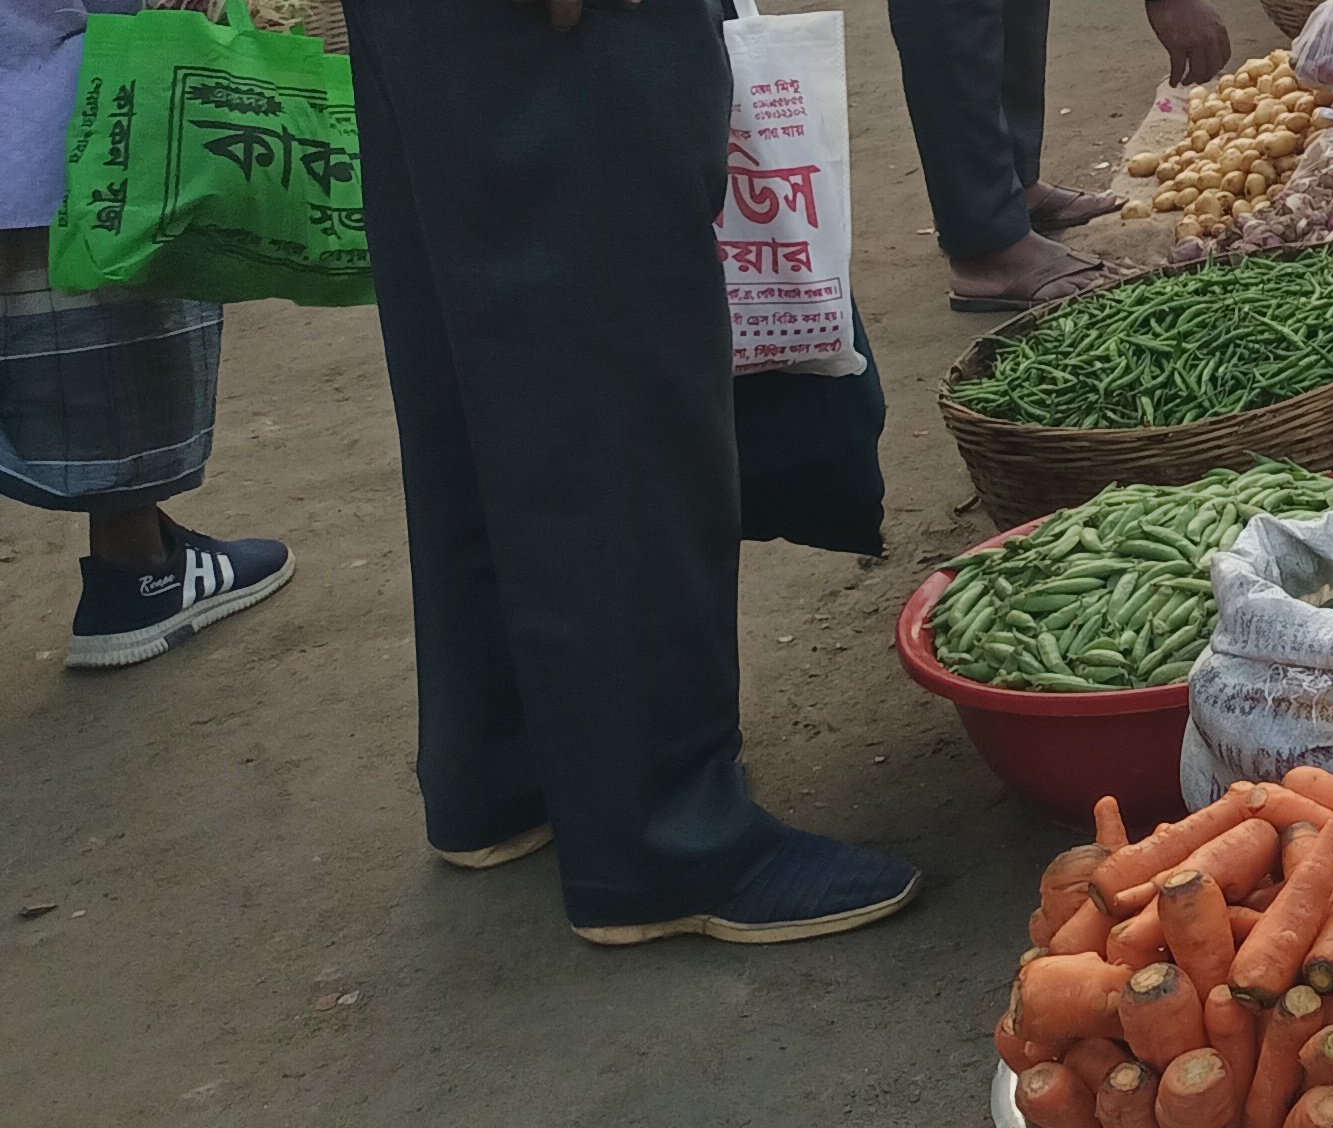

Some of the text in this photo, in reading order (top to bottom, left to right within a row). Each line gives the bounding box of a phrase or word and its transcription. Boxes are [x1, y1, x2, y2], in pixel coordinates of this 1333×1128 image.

[187, 123, 362, 199] কাক
[772, 311, 798, 325] বিক্রি
[801, 312, 821, 323] করা
